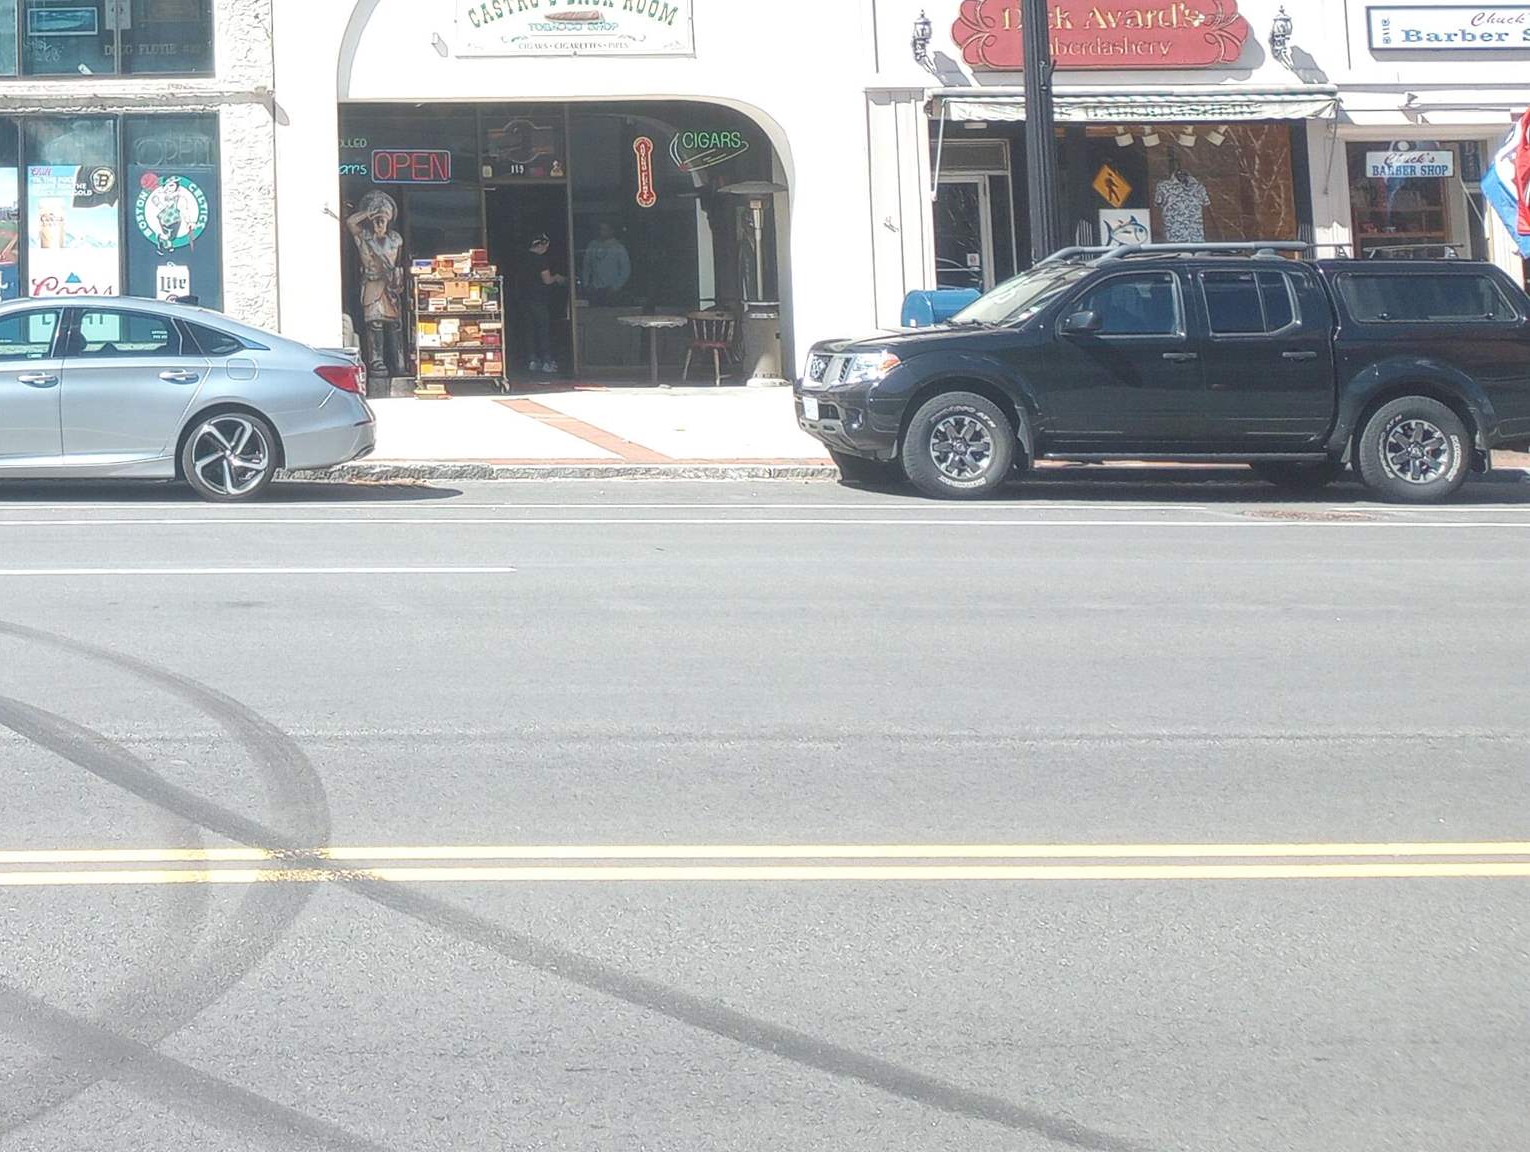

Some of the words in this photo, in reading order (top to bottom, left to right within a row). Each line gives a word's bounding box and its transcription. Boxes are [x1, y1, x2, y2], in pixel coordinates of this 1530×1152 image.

[1401, 28, 1510, 43] Barber
[682, 132, 743, 148] CIGARS
[374, 152, 449, 181] OPEN
[1420, 165, 1448, 177] SHOP
[135, 190, 152, 238] BOSTON
[188, 182, 208, 230] CELTICS
[160, 275, 187, 293] Lite
